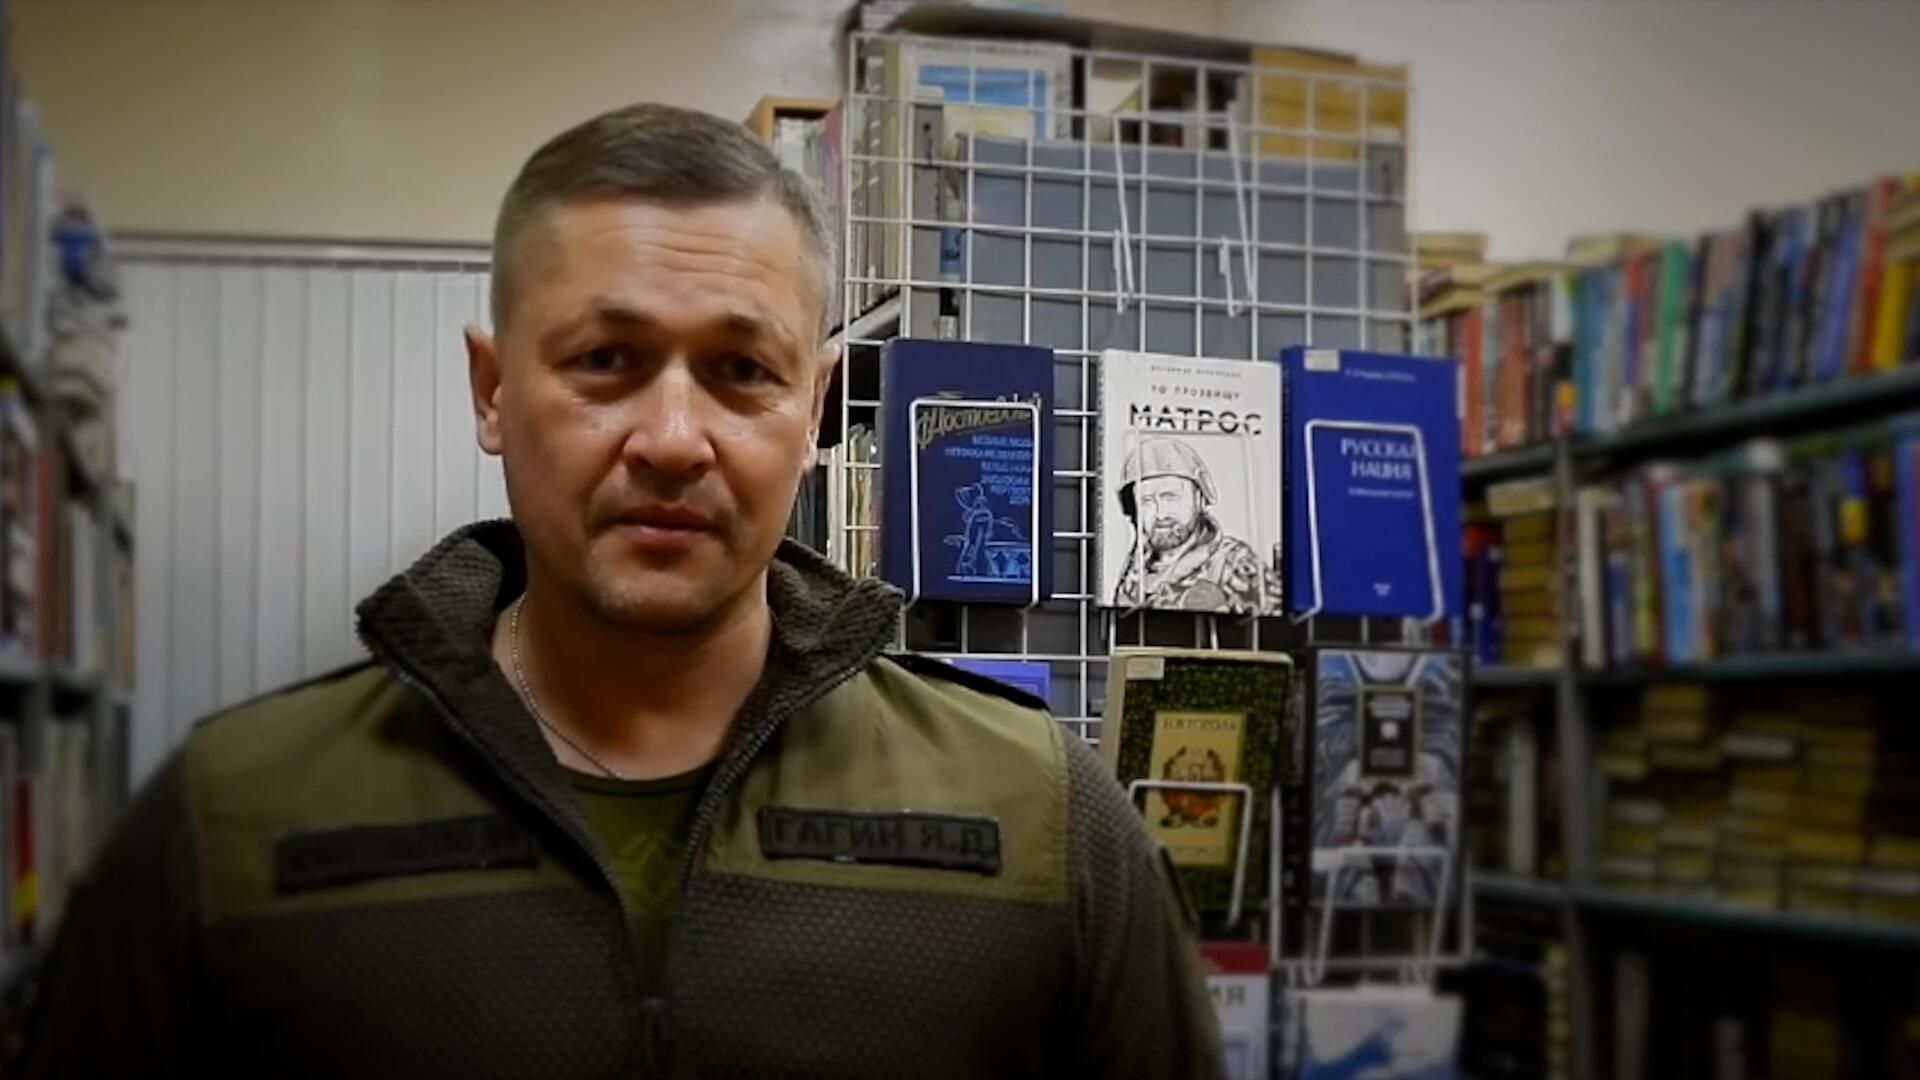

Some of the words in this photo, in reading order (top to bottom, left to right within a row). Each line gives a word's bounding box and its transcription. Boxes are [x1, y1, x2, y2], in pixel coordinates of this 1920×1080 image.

[1174, 385, 1240, 400] ПРОЗВИЩУ
[1129, 402, 1262, 435] МАТРОС
[1351, 460, 1412, 481] НАЦИЯ
[774, 815, 907, 850] ГАГИН
